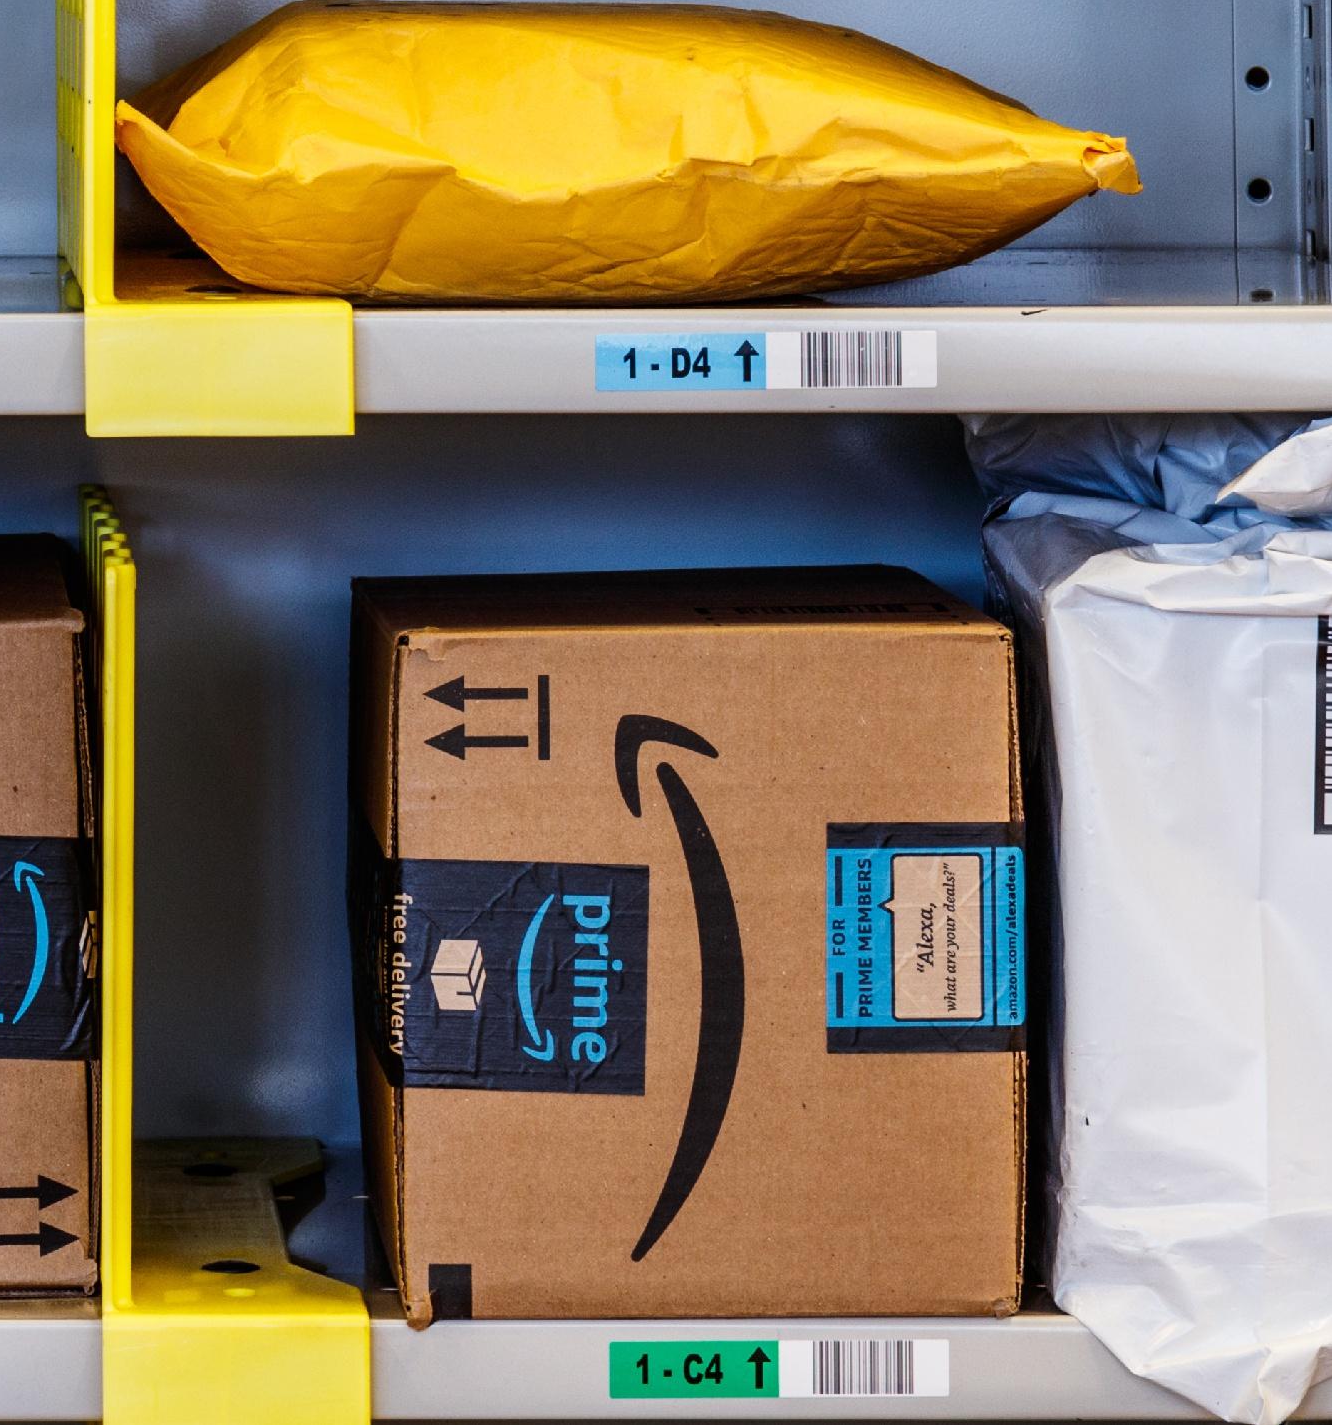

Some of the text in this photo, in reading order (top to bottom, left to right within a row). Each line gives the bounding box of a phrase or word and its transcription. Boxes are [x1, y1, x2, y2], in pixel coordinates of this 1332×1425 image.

[623, 347, 711, 378] 1 D4
[832, 918, 846, 956] FOR
[857, 858, 873, 1017] PRIME MEMBERS
[944, 917, 960, 950] your
[1005, 855, 1017, 1020] amazon.com/alexadeals
[388, 892, 413, 1056] free delivery
[562, 895, 623, 1063] prime
[947, 950, 957, 974] are
[943, 976, 957, 1012] what
[636, 1353, 723, 1385] 1 C4
